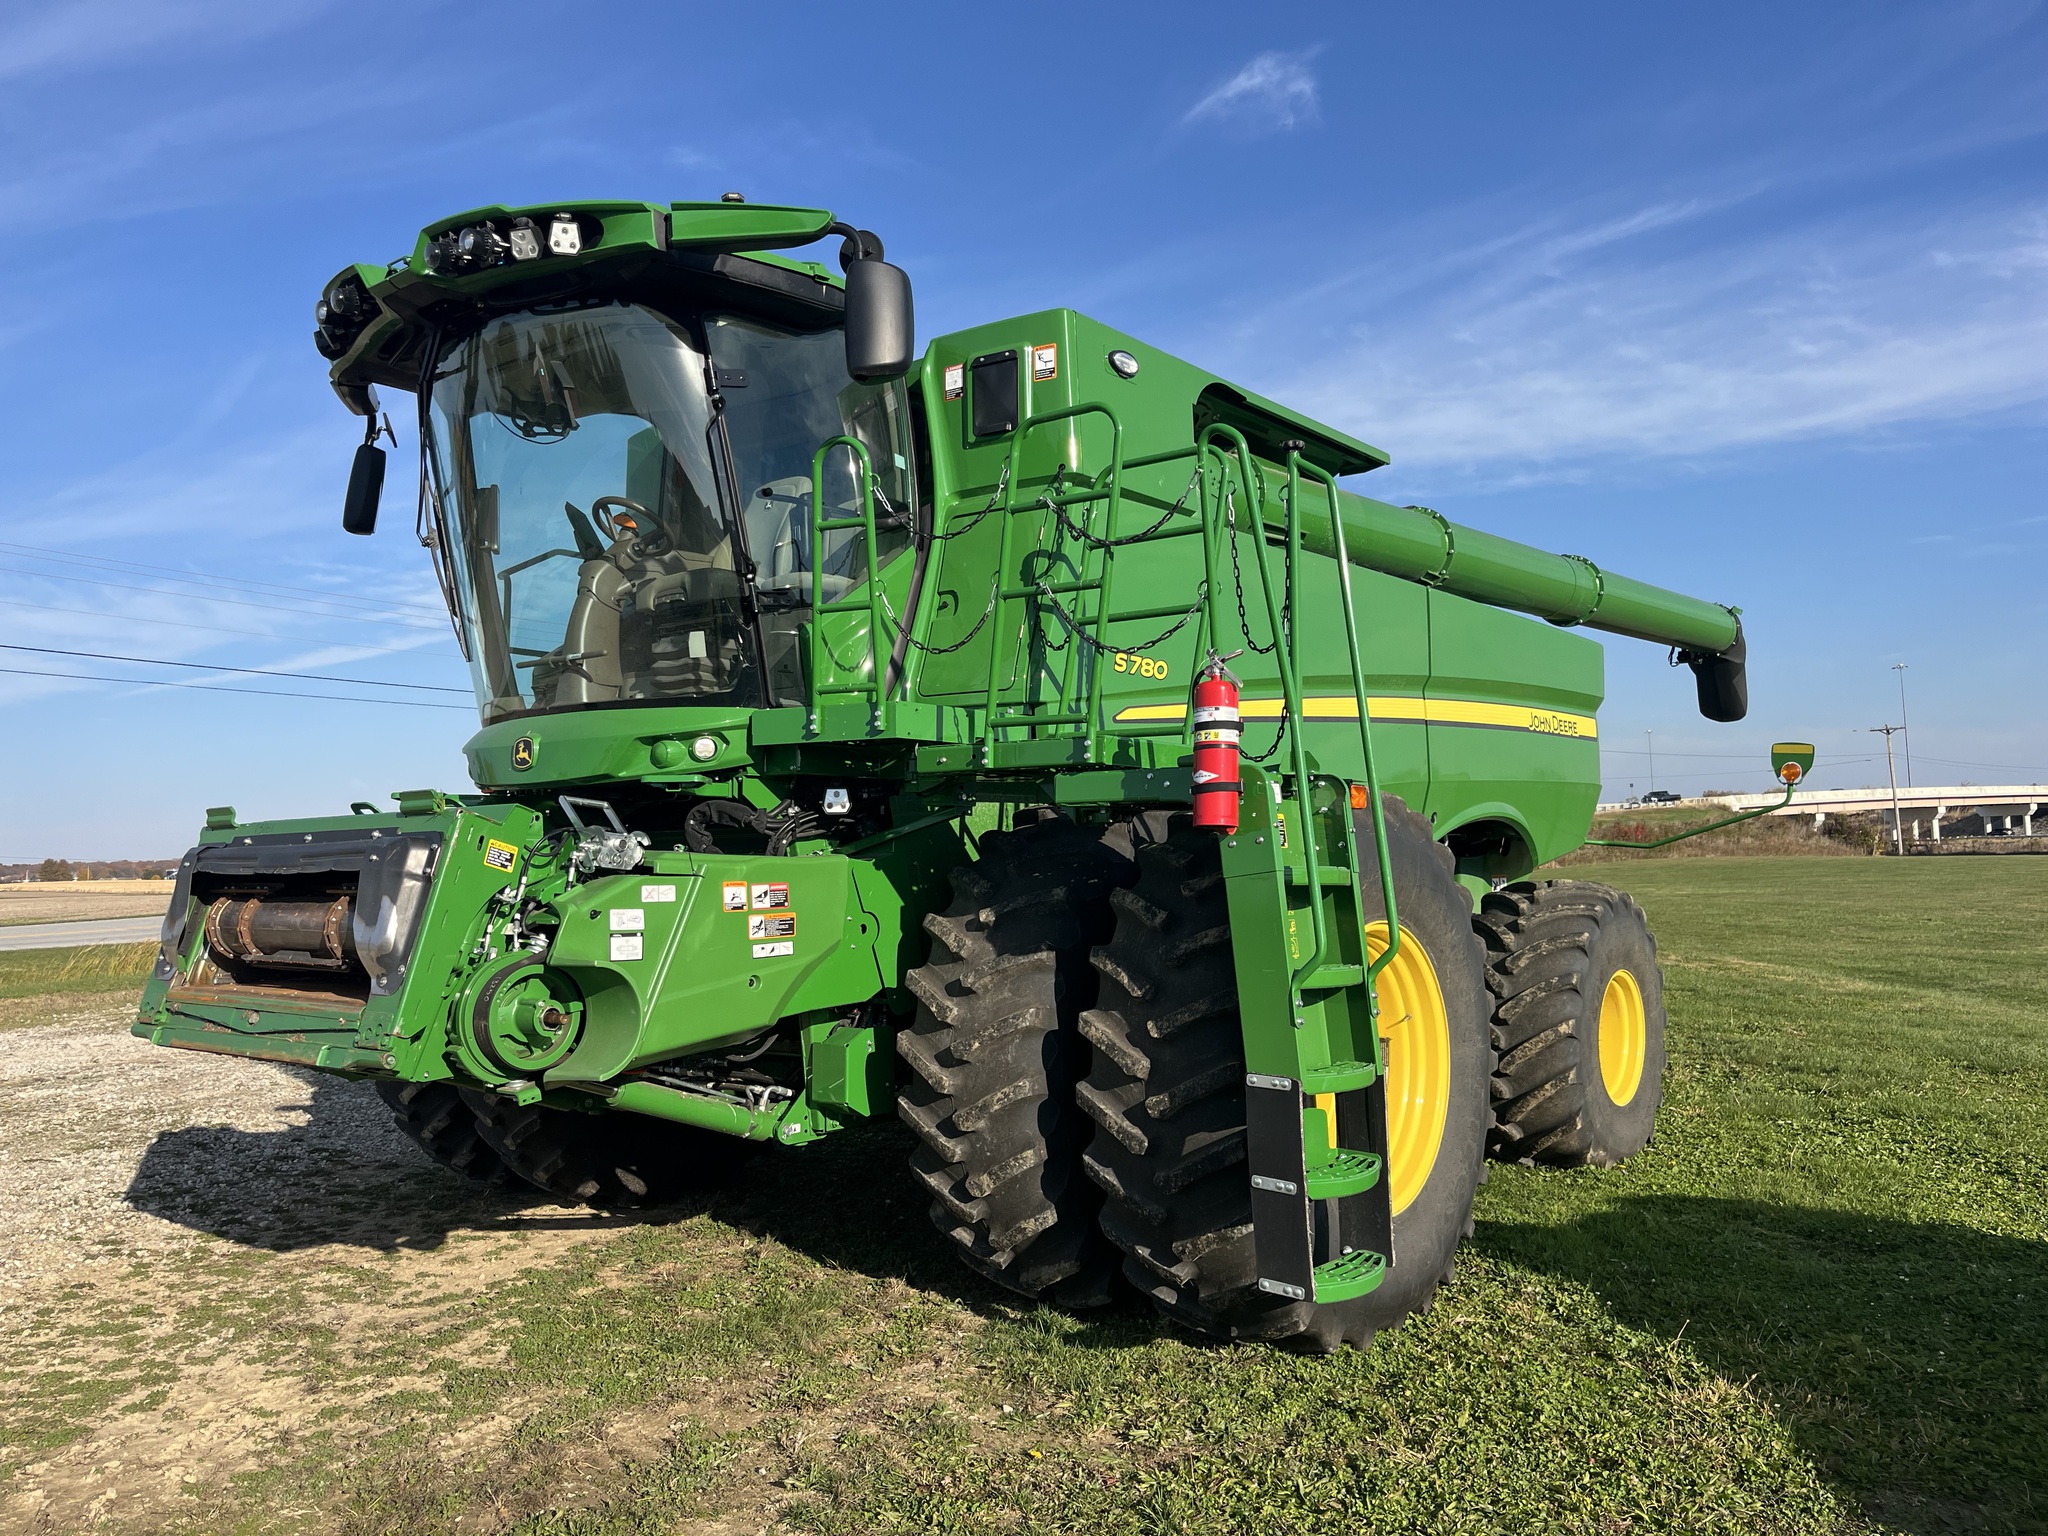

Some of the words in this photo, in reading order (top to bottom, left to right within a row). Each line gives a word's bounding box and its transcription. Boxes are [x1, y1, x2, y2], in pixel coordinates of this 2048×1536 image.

[1113, 651, 1169, 680] S780
[1529, 712, 1552, 731] JOHN
[1552, 715, 1578, 734] DEERE
